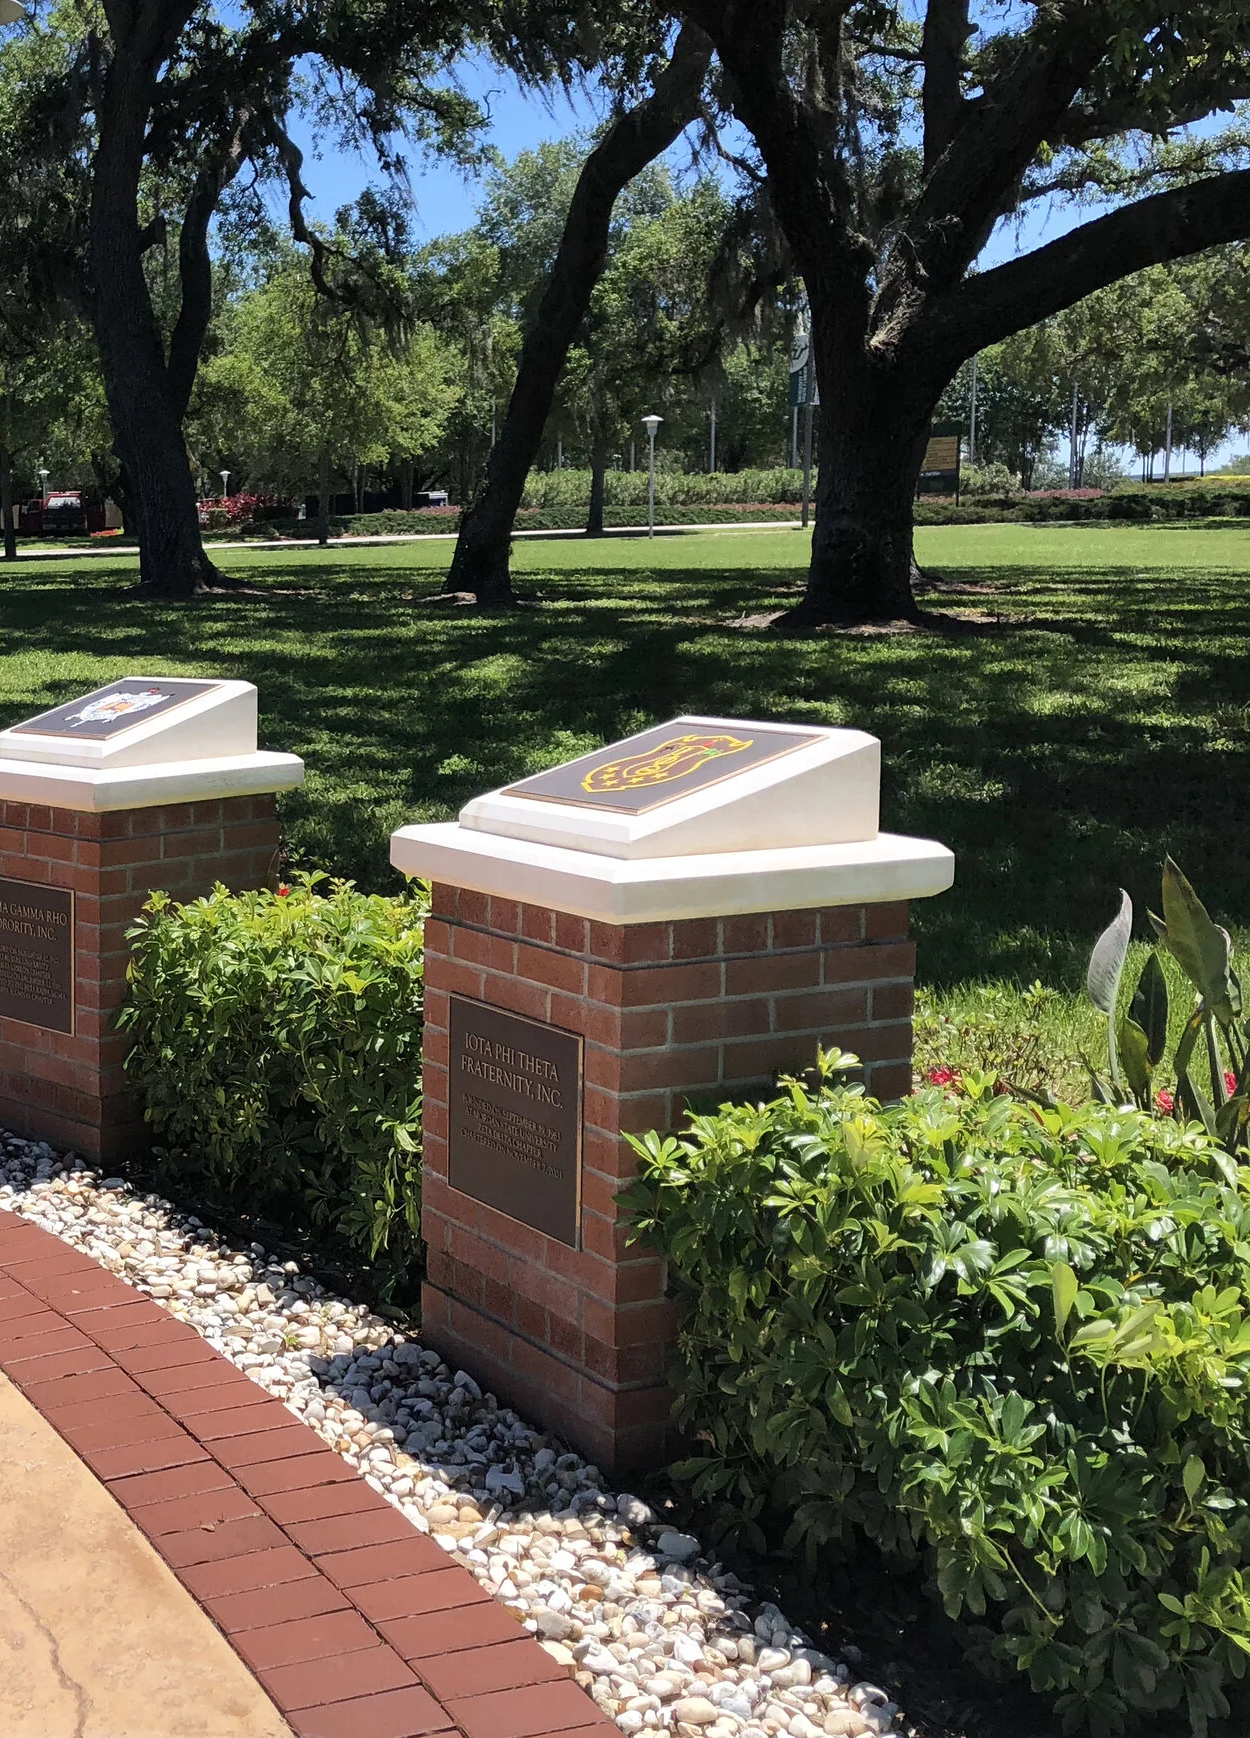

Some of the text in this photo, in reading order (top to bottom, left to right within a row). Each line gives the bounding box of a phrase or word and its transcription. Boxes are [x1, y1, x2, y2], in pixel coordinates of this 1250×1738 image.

[10, 903, 45, 922] GAMMA
[46, 910, 68, 926] RHO
[37, 926, 57, 941] INC.
[465, 1032, 559, 1081] IOTA PHI THETA
[461, 1055, 563, 1108] FRATERNITY, INC.
[502, 1108, 536, 1131] SEPTEMBER
[501, 1121, 519, 1137] STATE
[519, 1127, 559, 1153] UNIVERSITY
[512, 1138, 542, 1158] CHAPTER
